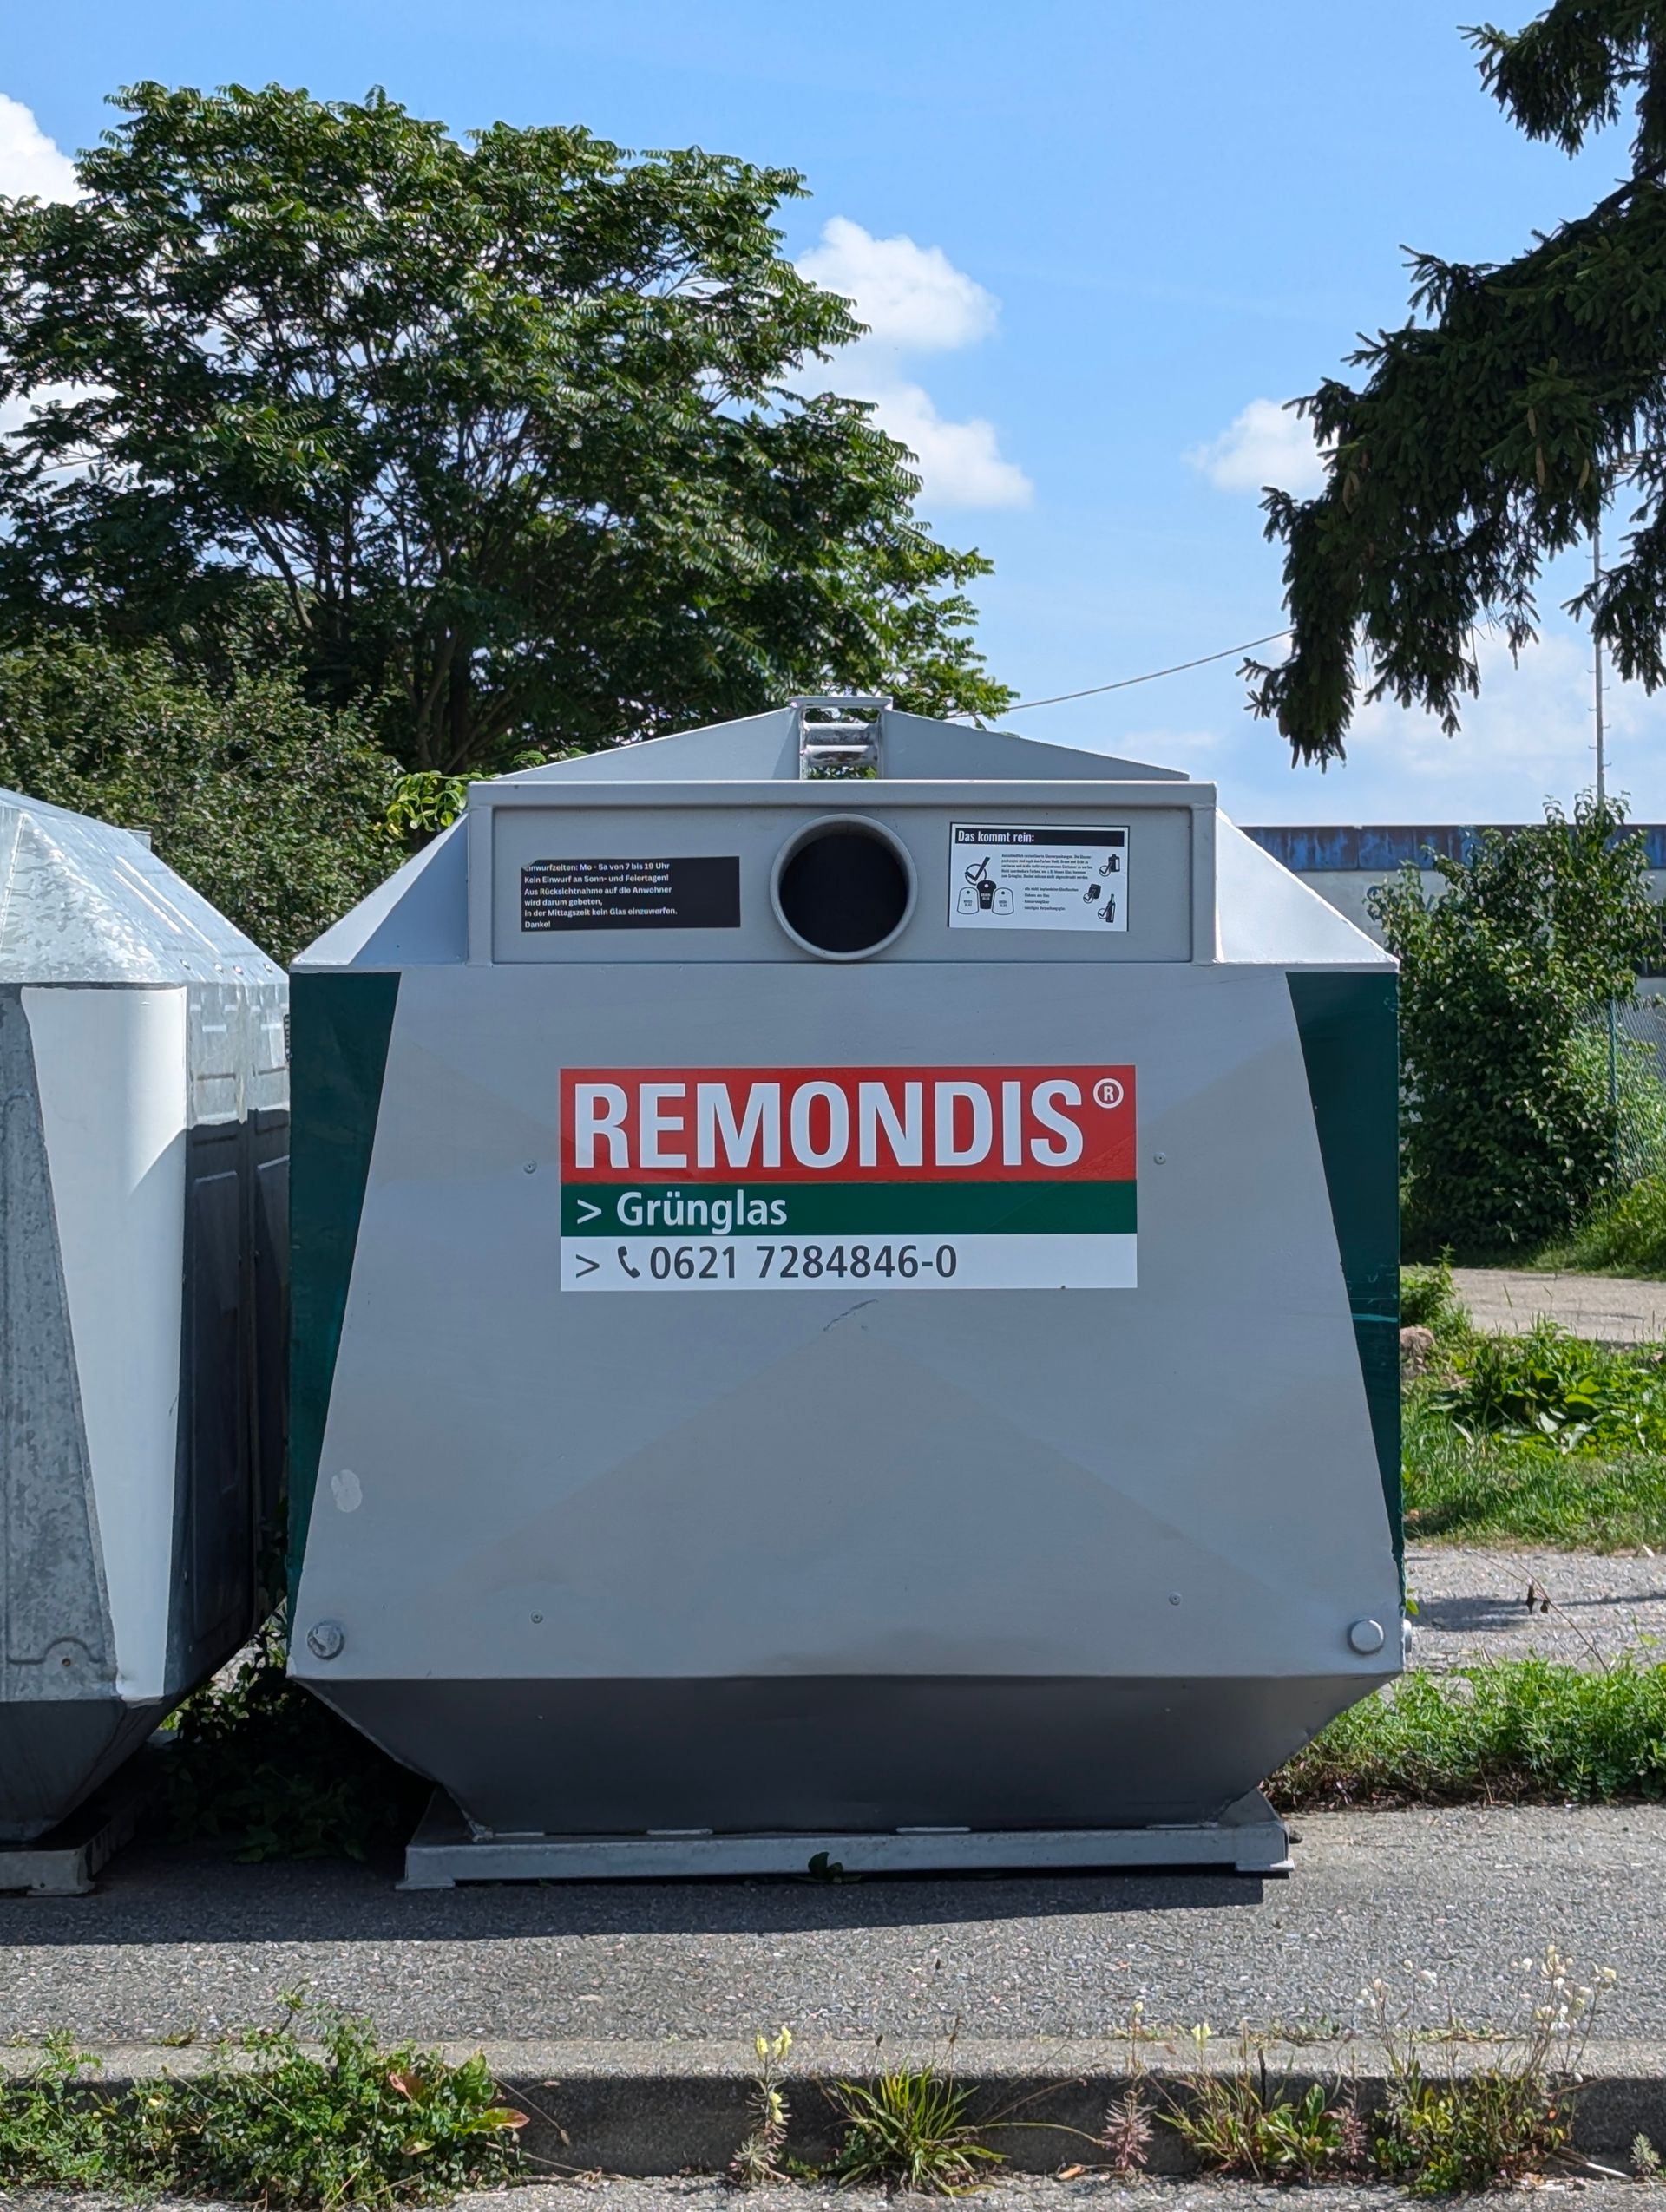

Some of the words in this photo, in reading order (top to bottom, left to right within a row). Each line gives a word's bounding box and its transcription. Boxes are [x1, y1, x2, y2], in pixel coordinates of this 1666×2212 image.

[958, 830, 975, 841] Das
[978, 831, 1010, 842] kommt
[1013, 832, 1034, 843] rein:
[542, 875, 573, 884] Einwurf
[626, 874, 669, 884] Feiertagen!
[524, 887, 538, 896] Aus
[540, 887, 604, 895] Rücksichtnahme
[619, 886, 631, 894] die
[633, 886, 672, 894] Anwohner
[568, 898, 603, 907] gebeten,
[548, 908, 591, 919] Mittagszeit
[592, 907, 607, 916] kein
[610, 907, 626, 916] Glas
[628, 906, 678, 916] einzuwerfen.
[525, 920, 551, 929] Danke!
[616, 1189, 787, 1234] Grünglas
[649, 1245, 737, 1279] 0621
[757, 1244, 958, 1279] 7284846-0
